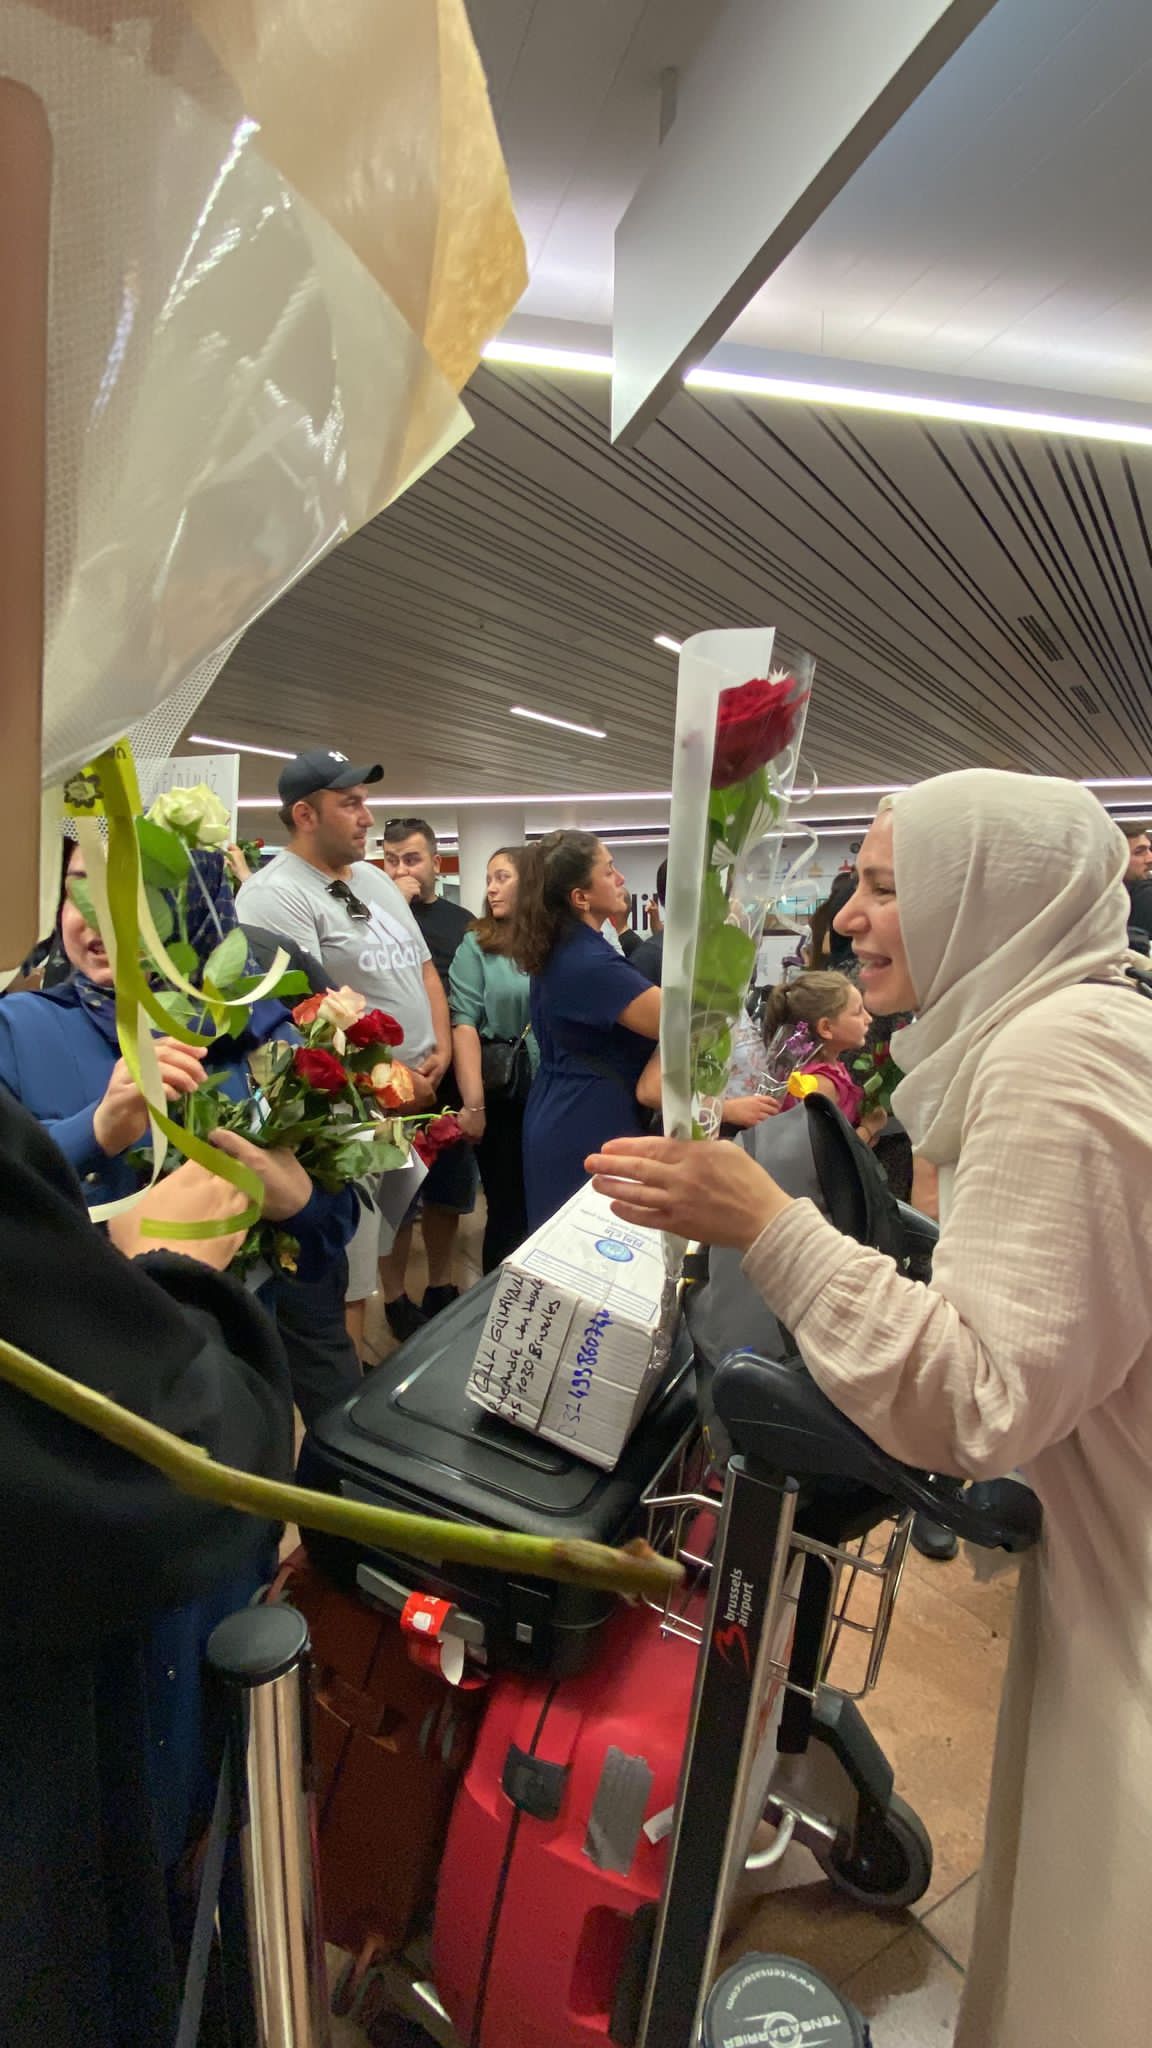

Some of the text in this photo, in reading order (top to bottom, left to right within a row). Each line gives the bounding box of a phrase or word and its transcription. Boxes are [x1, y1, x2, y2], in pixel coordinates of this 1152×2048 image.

[358, 943, 421, 972] adda
[515, 1360, 534, 1392] 1030
[723, 1568, 743, 1621] brussels
[737, 1582, 754, 1627] airport
[725, 1967, 816, 2011] www.tensator.com
[722, 2013, 841, 2048] TENSABARRIER
